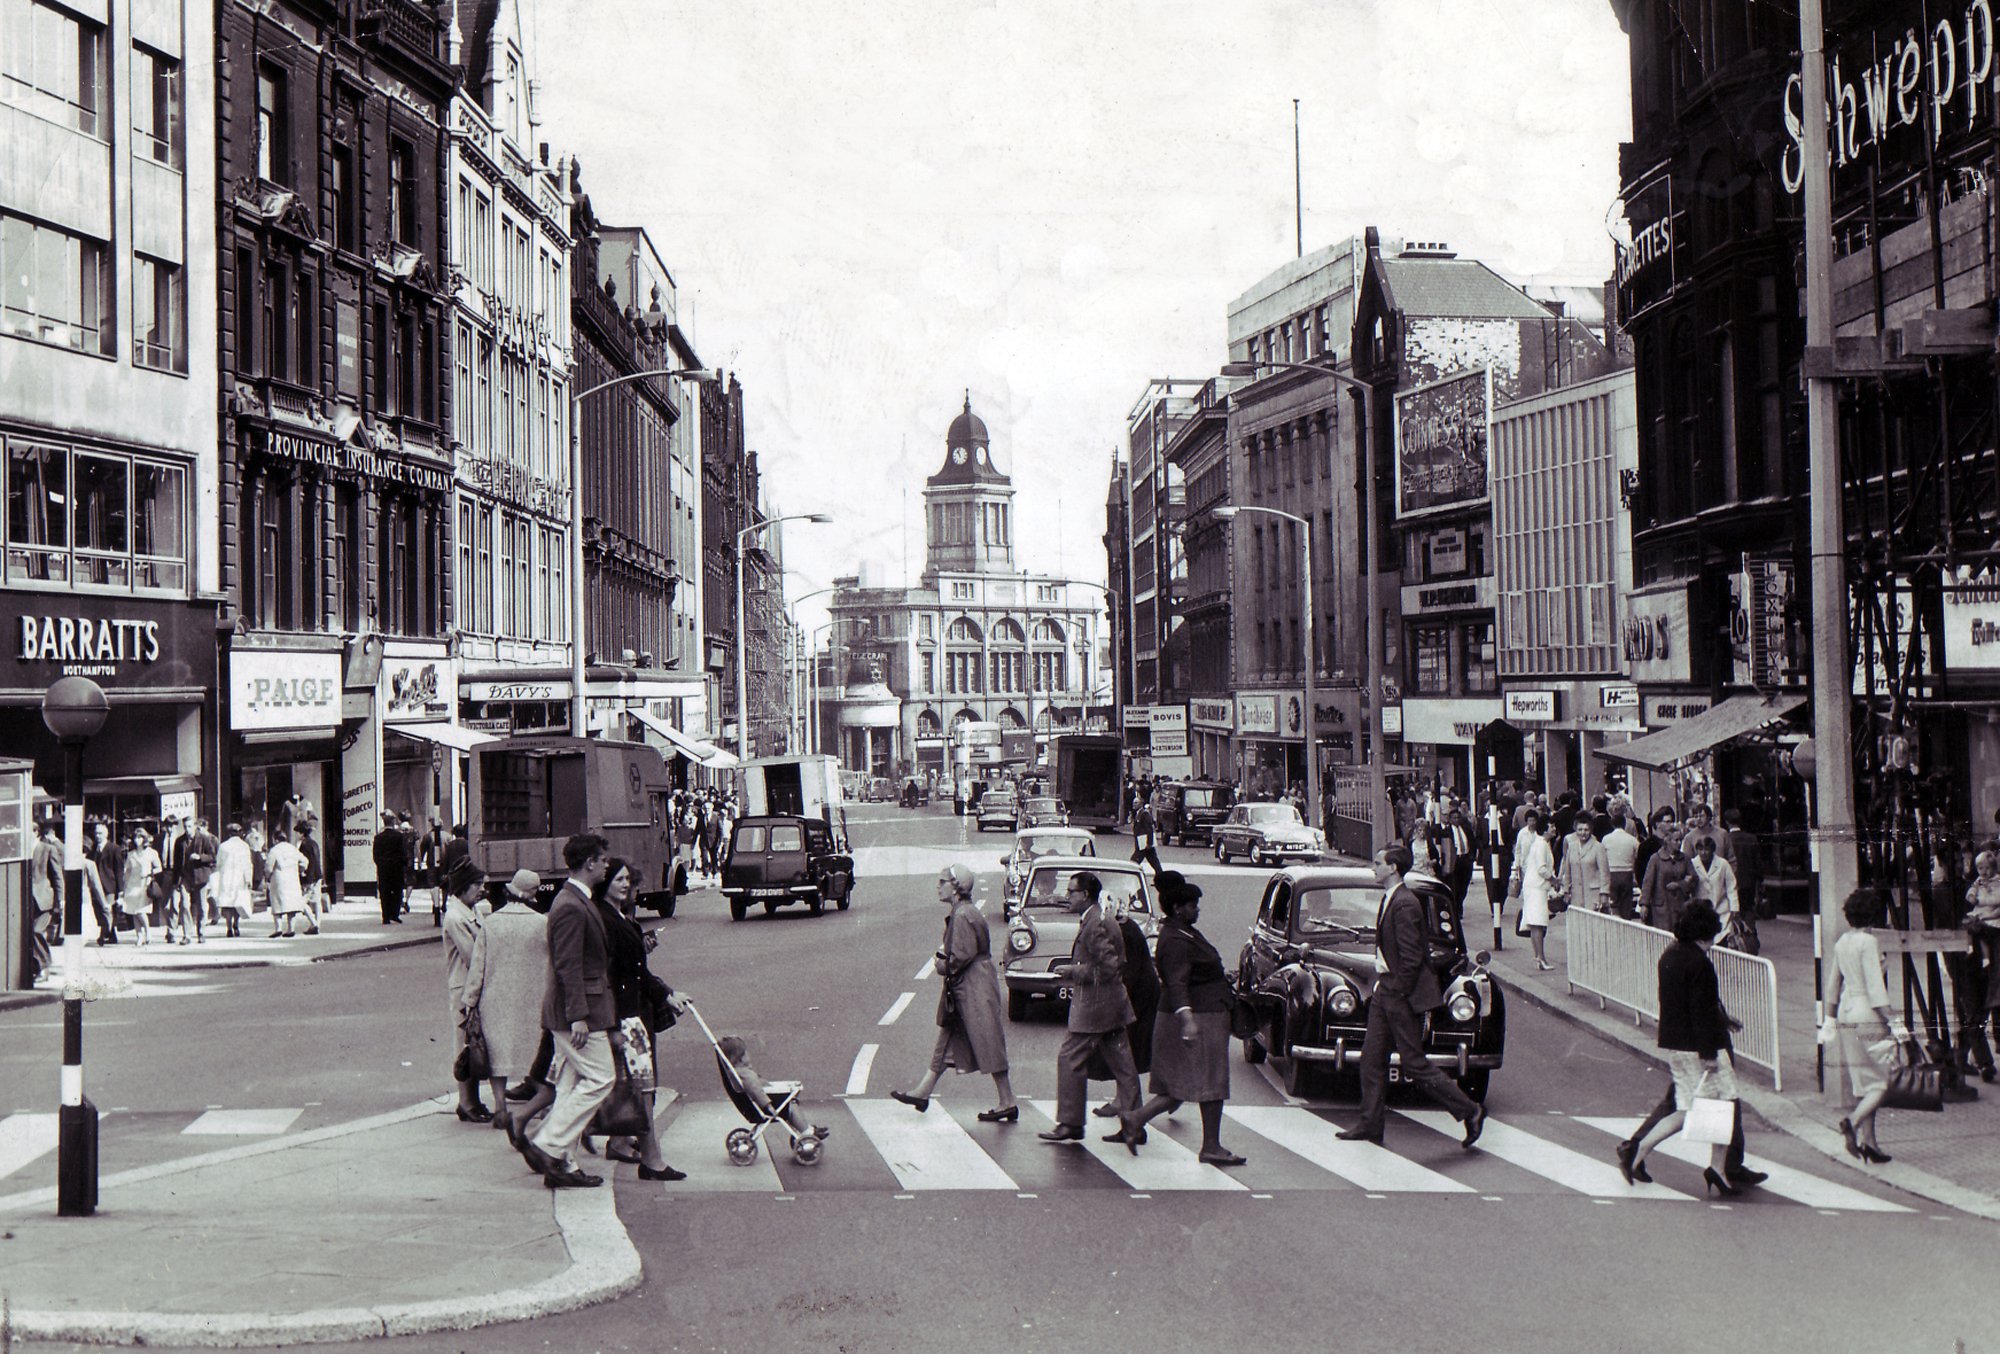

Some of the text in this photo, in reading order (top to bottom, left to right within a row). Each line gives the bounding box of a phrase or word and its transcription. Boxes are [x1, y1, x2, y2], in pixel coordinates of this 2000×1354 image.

[1782, 0, 1993, 194] Shwepp
[268, 432, 338, 466] PROVINCIAL
[346, 450, 402, 480] INSURANCE
[410, 466, 455, 492] COMPANY
[19, 615, 160, 663] BARRATTS
[63, 665, 116, 676] NORTHAMPTON
[254, 678, 334, 701] PAIGE
[489, 684, 552, 699] DAVY'S
[1511, 695, 1549, 715] Hepworths
[343, 801, 373, 820] TOBACCO
